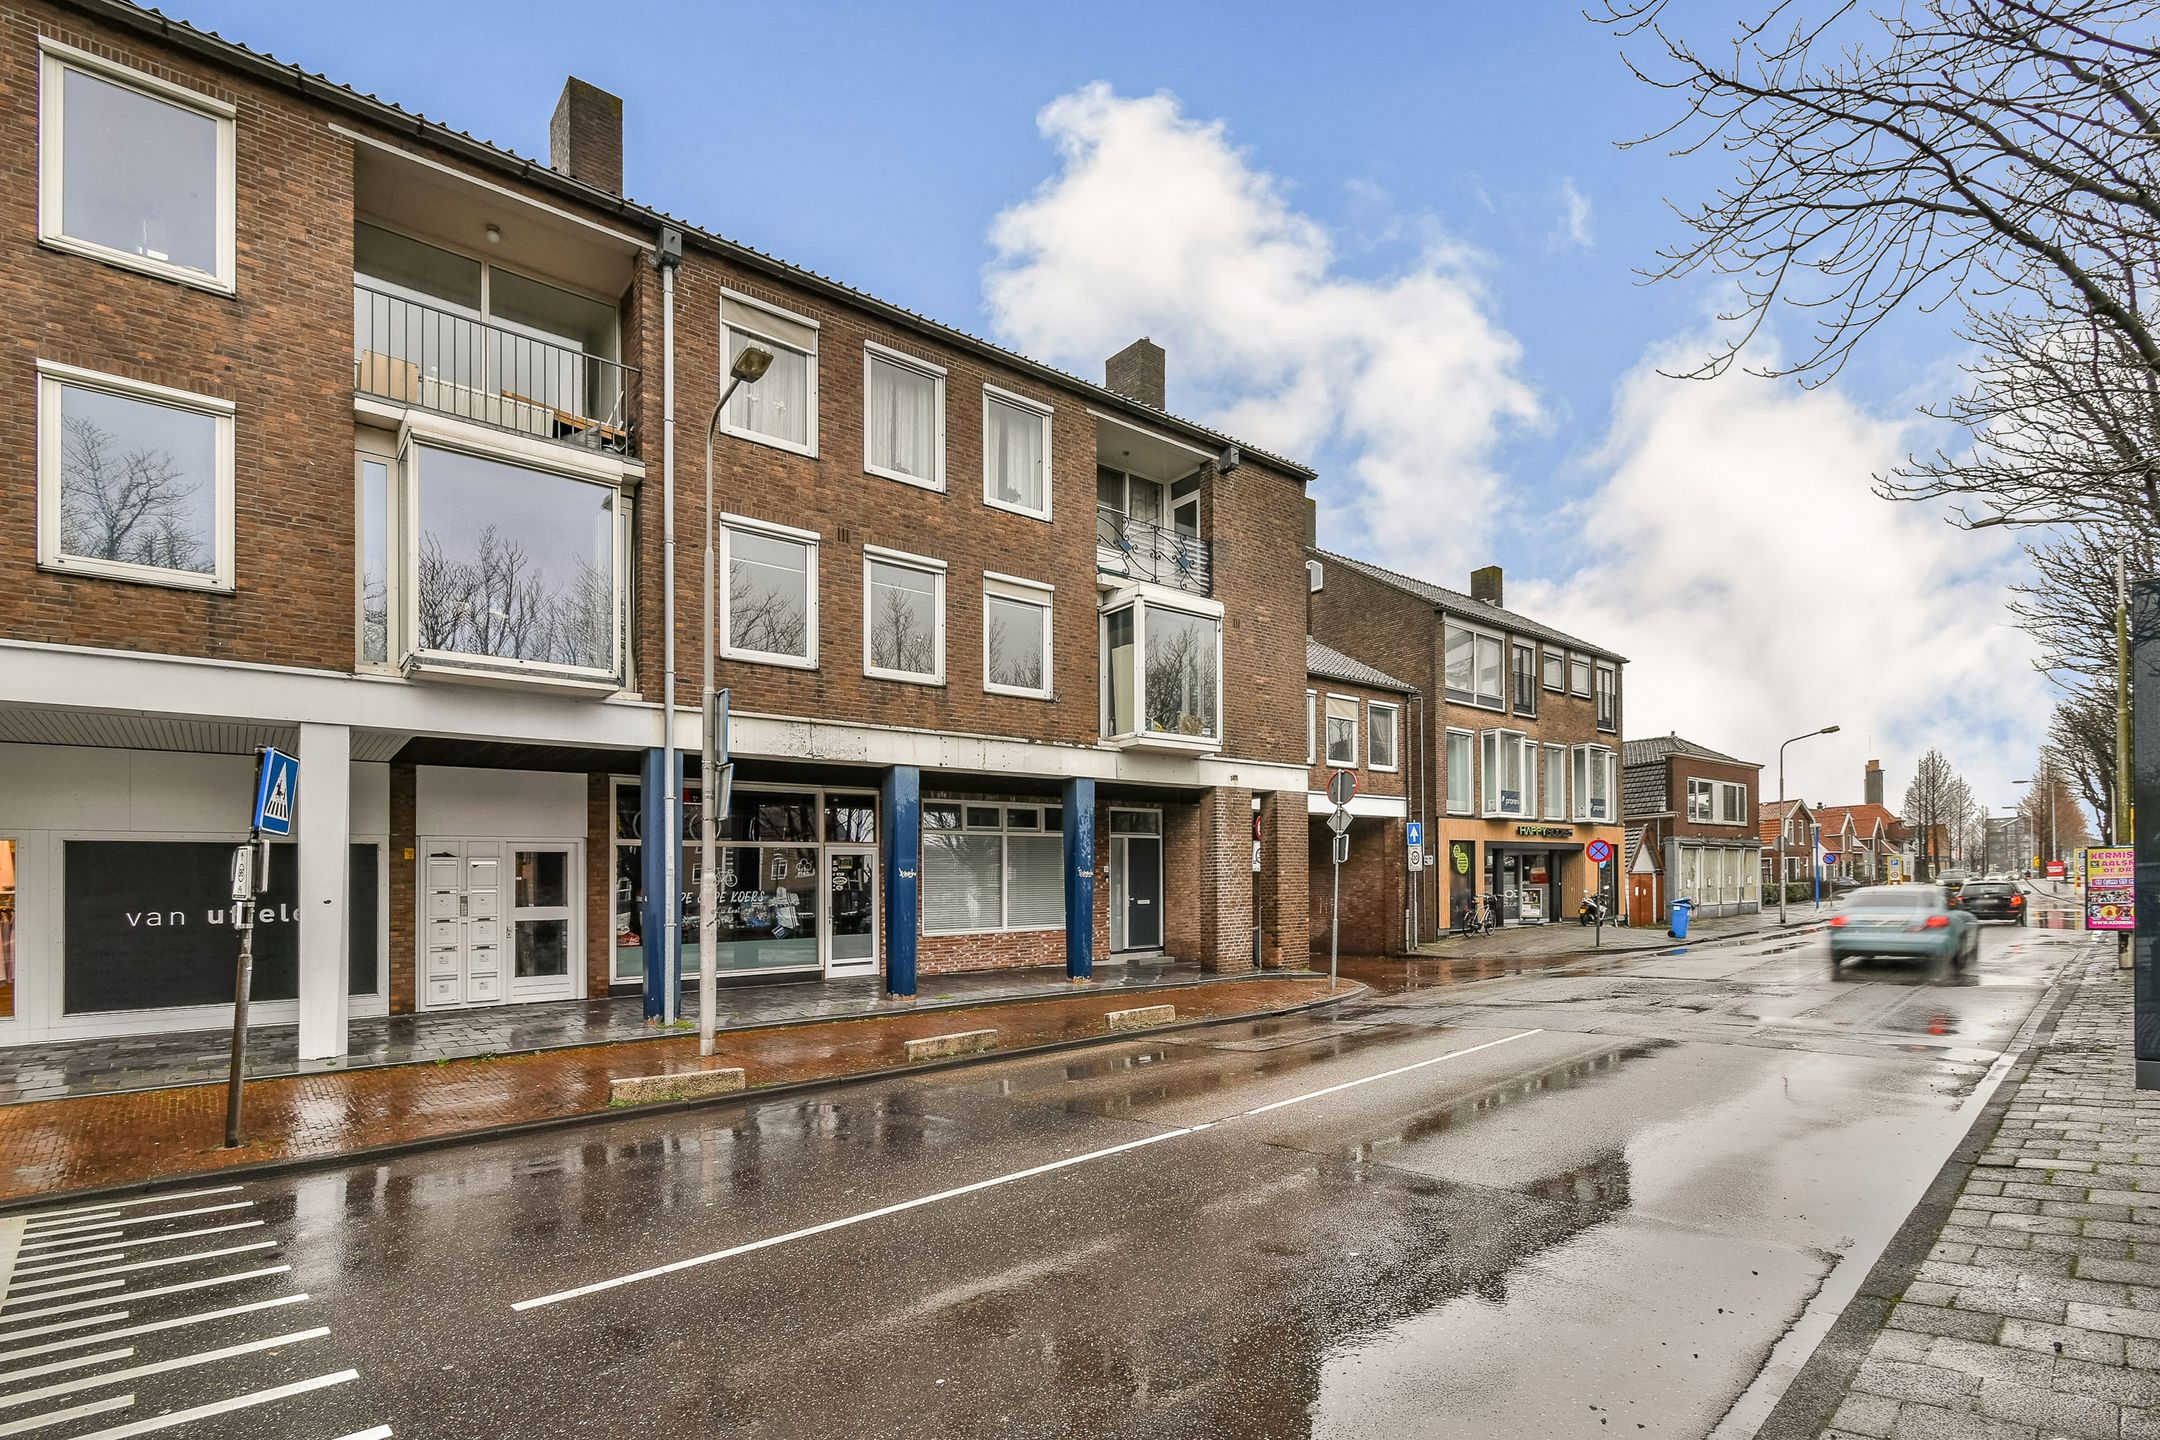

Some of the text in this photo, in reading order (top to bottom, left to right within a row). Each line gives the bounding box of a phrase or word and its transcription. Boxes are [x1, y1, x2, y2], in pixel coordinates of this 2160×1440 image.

[2091, 851, 2134, 860] KERMIS
[730, 890, 765, 903] KOERS
[125, 903, 300, 927] van ufel
